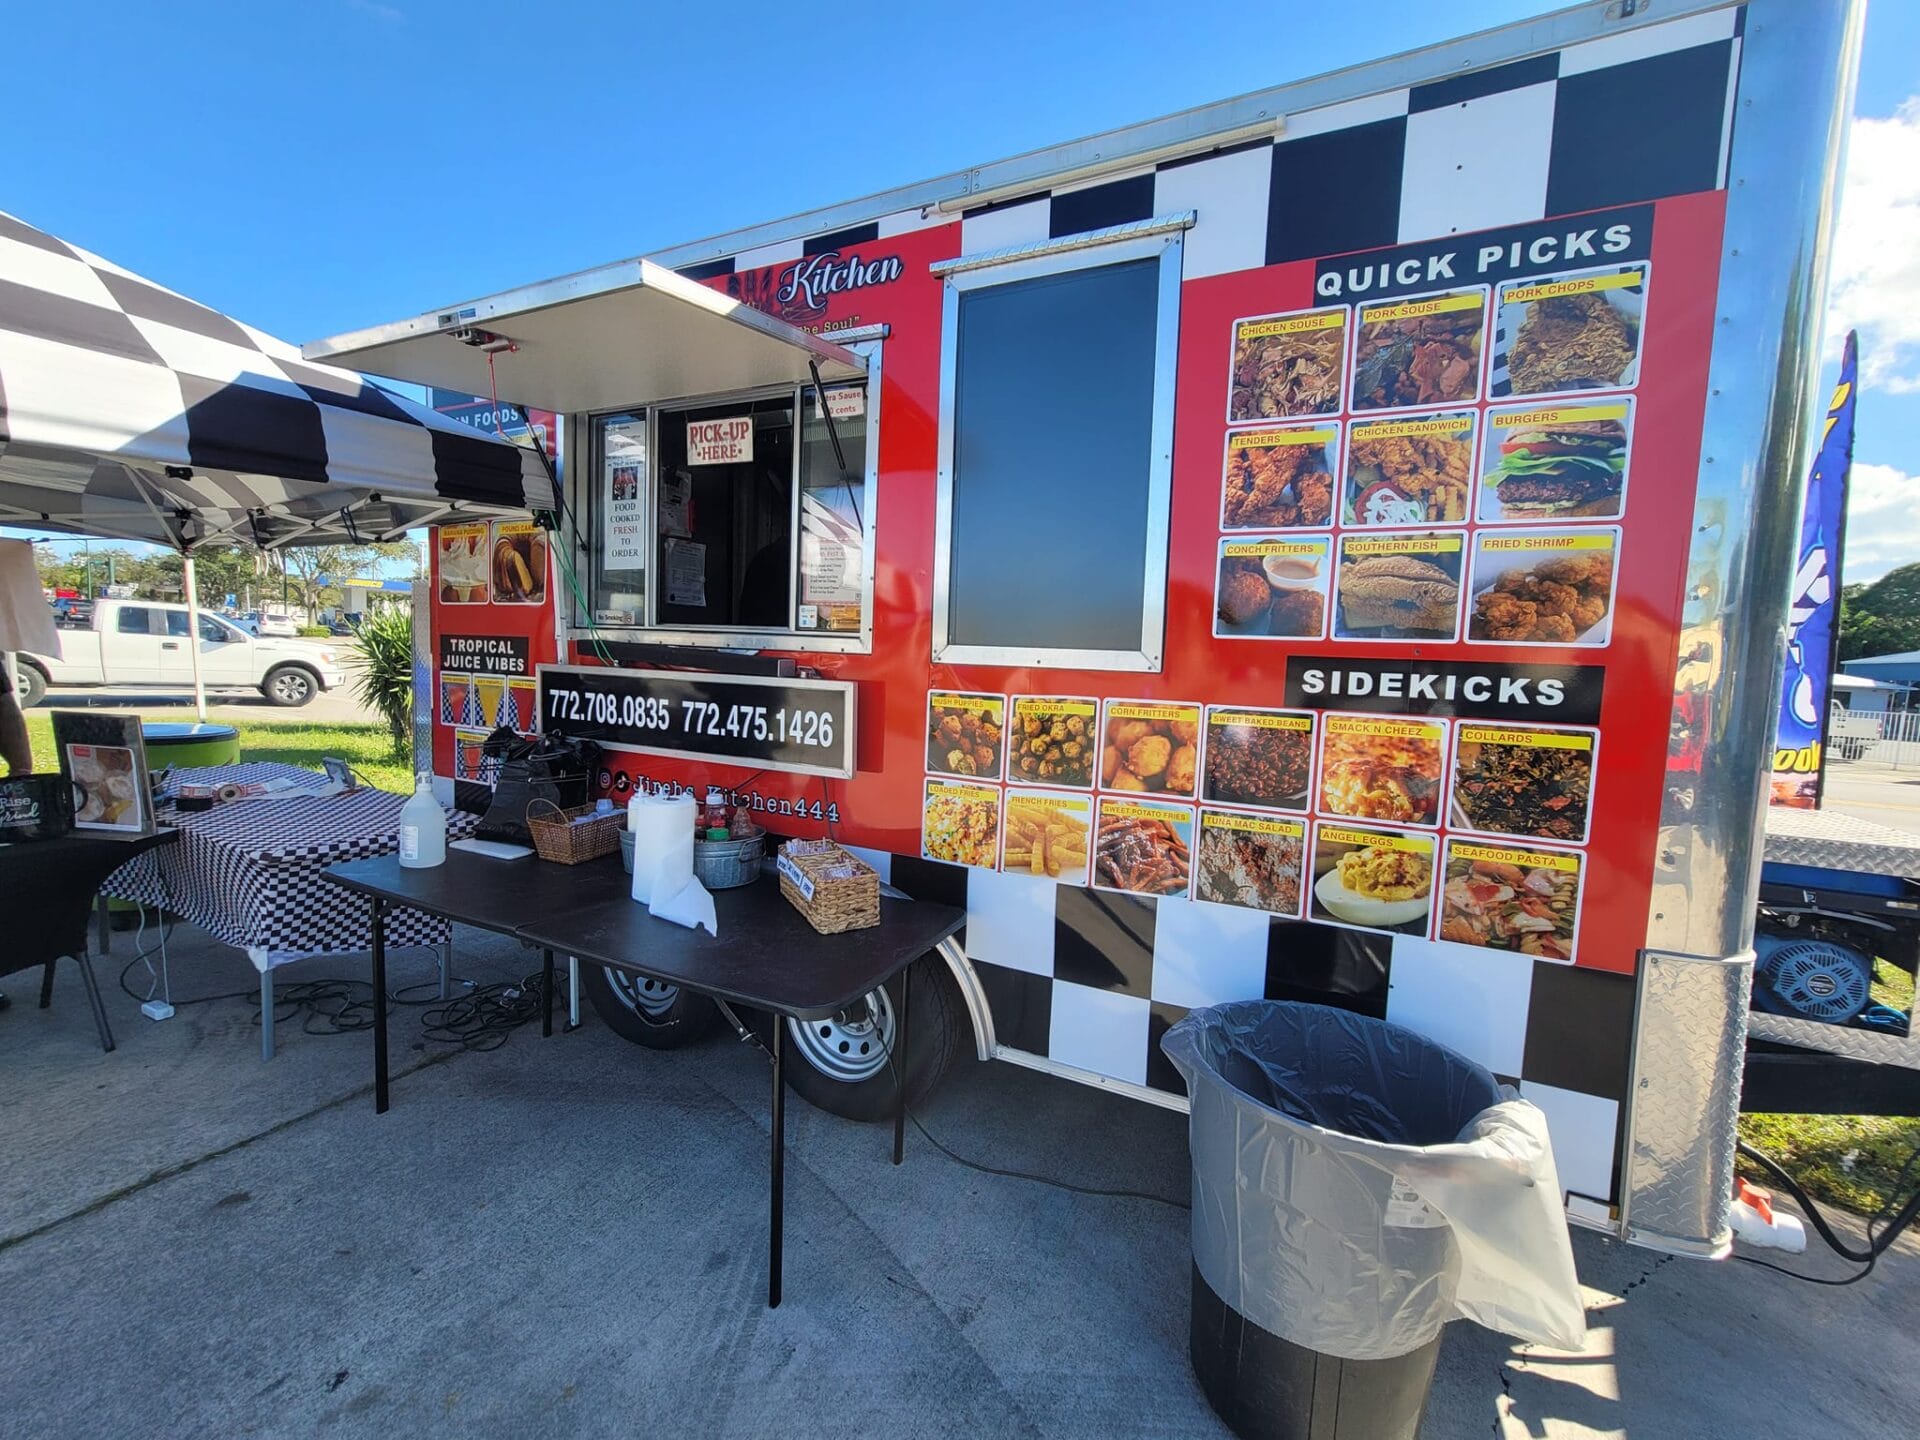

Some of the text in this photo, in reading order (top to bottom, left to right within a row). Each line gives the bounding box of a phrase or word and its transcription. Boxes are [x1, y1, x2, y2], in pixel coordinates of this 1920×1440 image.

[1316, 224, 1632, 297] QUICK PICKS
[778, 252, 903, 310] Kitchen
[1507, 280, 1596, 300] PORK CHOPS
[1365, 302, 1441, 321] PORK SOUSE
[1241, 318, 1326, 337] CHICKEN SOUSE
[835, 405, 856, 415] cents
[474, 408, 519, 428] FOODS
[1495, 412, 1559, 426] BURGERS
[690, 421, 750, 449] PICK-UP
[1356, 420, 1468, 438] CHICKEN SANDWICH
[1234, 435, 1281, 446] TENDERS
[614, 503, 636, 512] FOOD
[610, 514, 640, 523] COOKED
[613, 525, 639, 535] FRESH
[620, 538, 631, 546] TO
[1227, 544, 1314, 554] CONCH FRITTERS
[1348, 541, 1438, 553] SOUTHERN FISH
[1484, 538, 1575, 549] FRIED SHRIMP
[611, 548, 639, 558] ORDER
[450, 638, 514, 655] TROPICAL
[443, 655, 525, 672] JUICE VIBES
[1301, 669, 1565, 706] SIDEKICKS
[933, 698, 984, 708] HUSH PUPPIES
[1017, 703, 1065, 712] FRIED OKRA
[549, 689, 834, 748] 772.708.0835 772.475.1426
[1110, 707, 1181, 719] CORN FRITTERS
[1213, 715, 1307, 729] SWEET BAKED BEANS
[1332, 722, 1423, 736] SMACK N CHEEZ
[1465, 731, 1533, 744] COLLARDS
[929, 785, 980, 799] LOADED FRIES
[1011, 796, 1068, 808] FRENCH FRIES
[1104, 805, 1186, 821] SWEET POTATO FRIES
[1206, 816, 1292, 834] TUNA MAC SALAD
[1322, 831, 1394, 848] ANGEL EGGS
[1454, 845, 1558, 868] SEAFOOD PASTA
